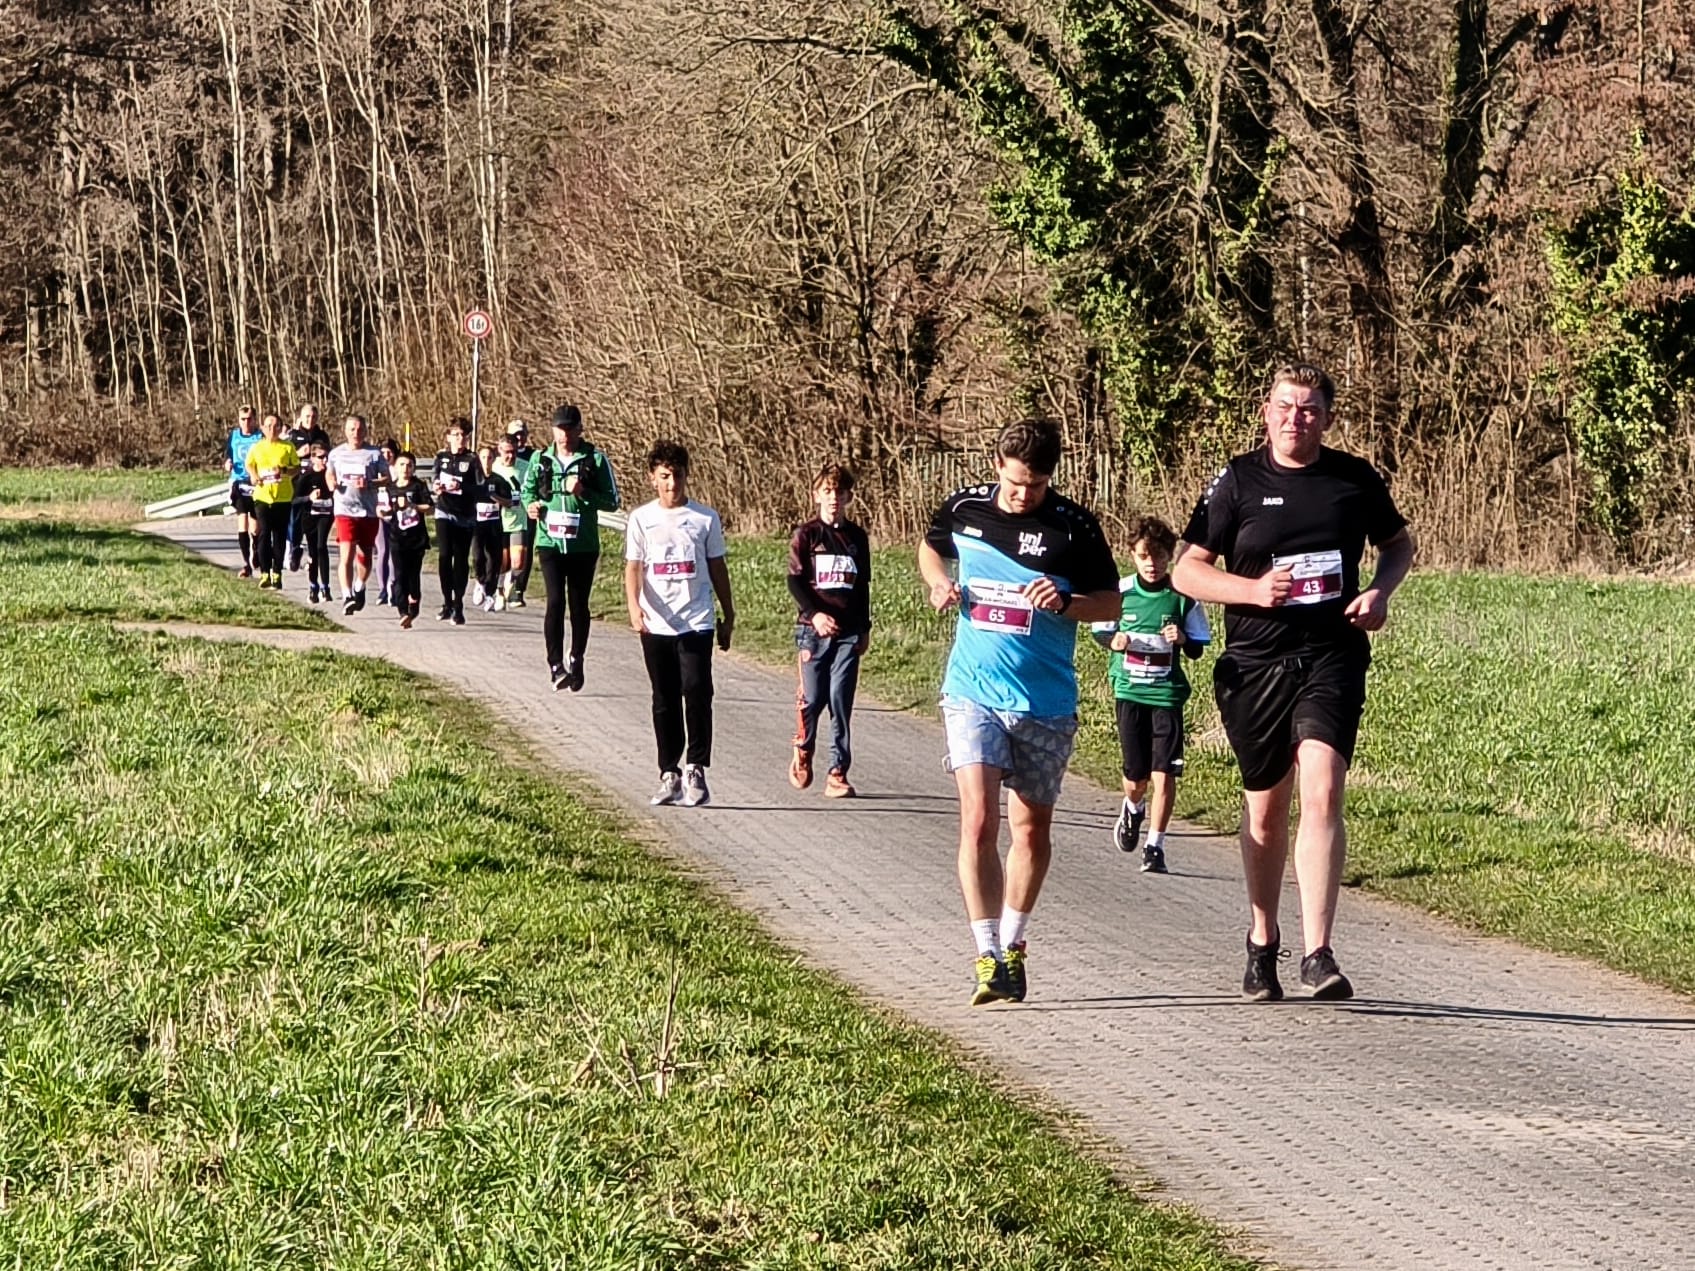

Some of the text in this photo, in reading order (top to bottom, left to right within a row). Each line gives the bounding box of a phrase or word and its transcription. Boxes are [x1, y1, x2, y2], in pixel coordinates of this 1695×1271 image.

[1018, 542, 1047, 556] per
[666, 564, 679, 574] 25
[1302, 580, 1321, 594] 43
[988, 608, 1006, 622] 65
